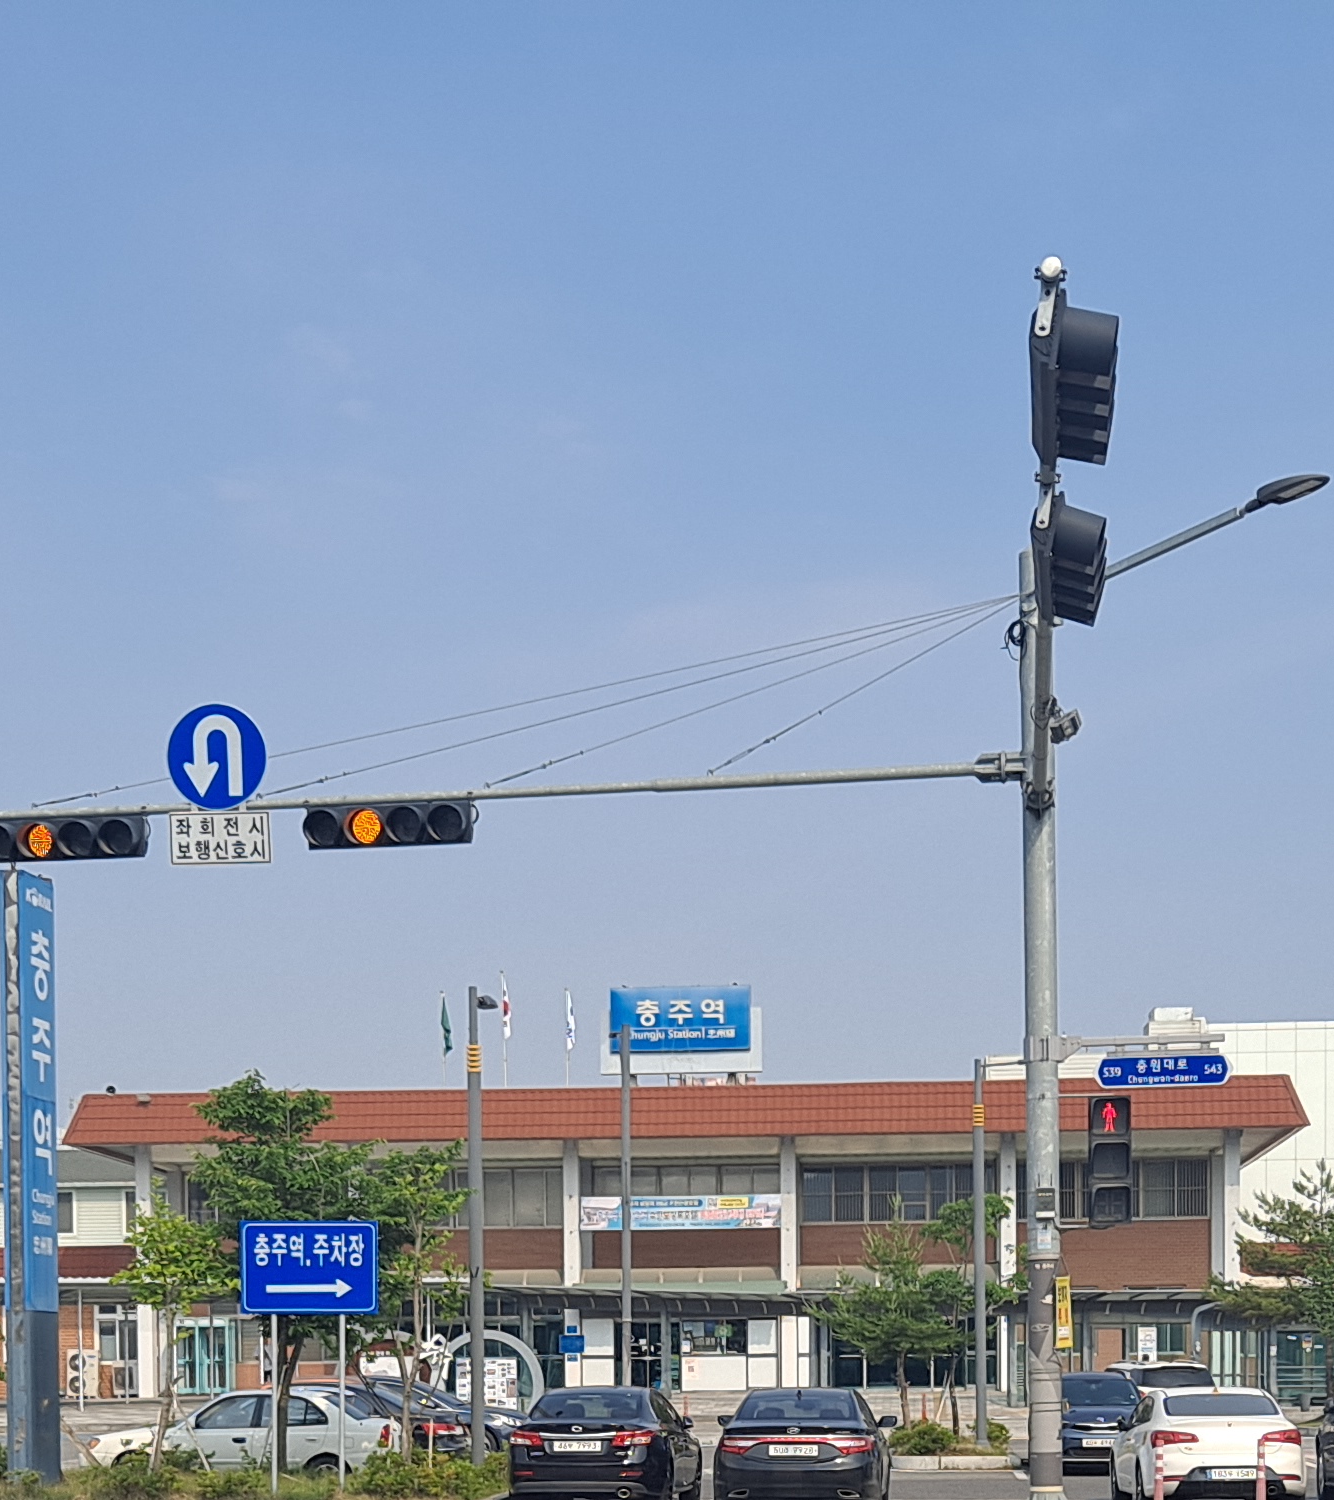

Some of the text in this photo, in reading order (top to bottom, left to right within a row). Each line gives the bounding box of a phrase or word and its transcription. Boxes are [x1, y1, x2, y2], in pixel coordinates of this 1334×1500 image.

[175, 838, 266, 861] 보행신호시
[629, 1028, 701, 1042] hungju Station
[1102, 1066, 1122, 1078] 539
[1204, 1063, 1223, 1075] 543
